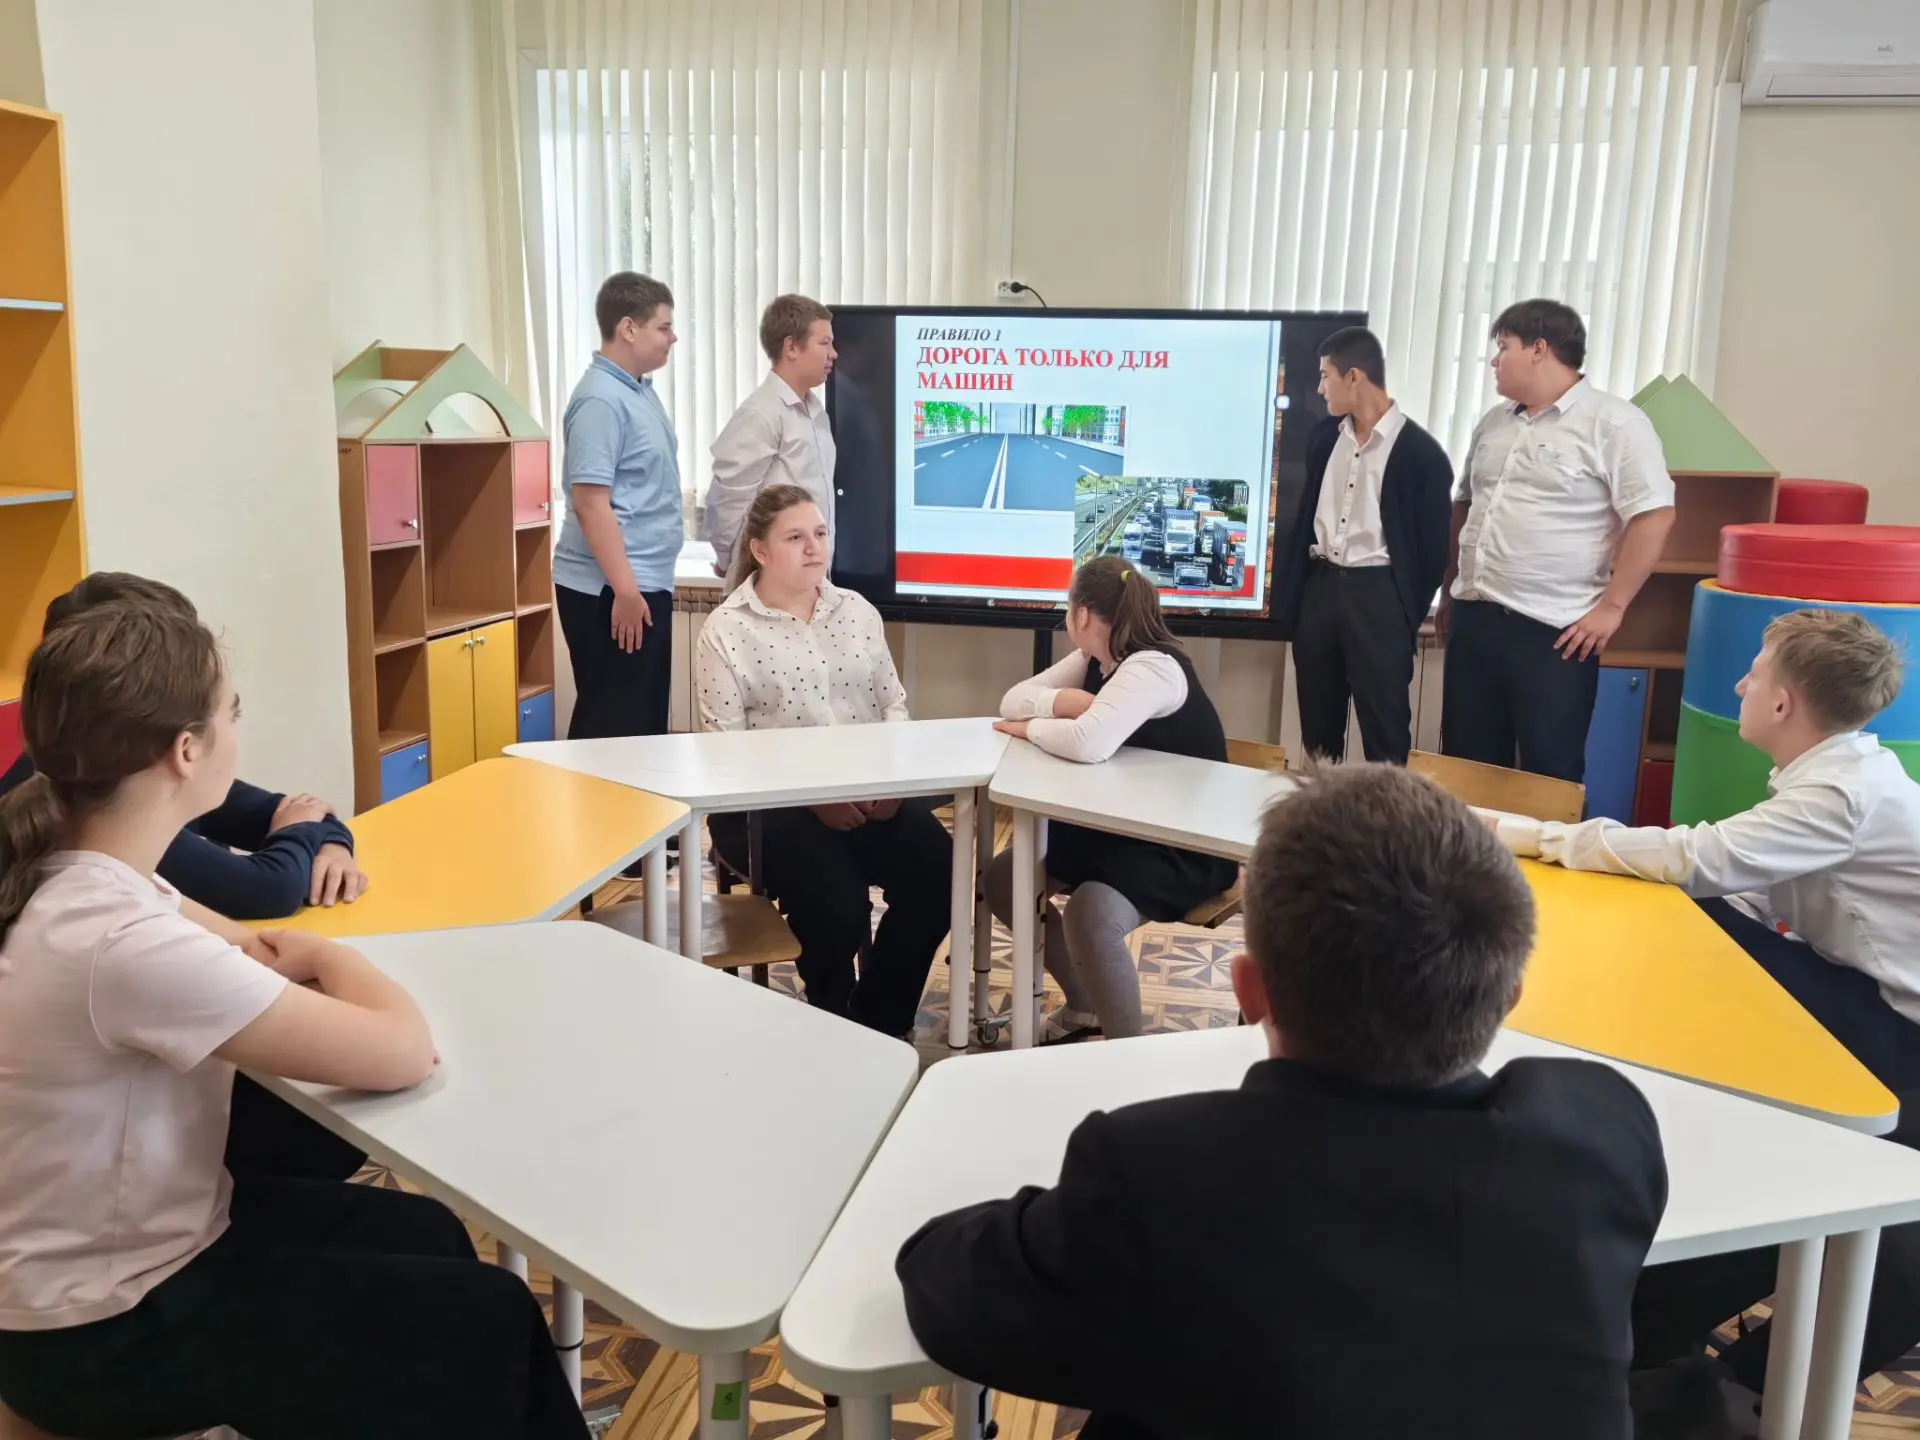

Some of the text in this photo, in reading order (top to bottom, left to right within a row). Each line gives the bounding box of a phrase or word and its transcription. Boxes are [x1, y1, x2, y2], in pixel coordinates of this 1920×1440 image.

[916, 328, 1002, 341] ПРАВИЛО 1
[916, 346, 1169, 371] ДОРОГА ТОЛЬКО ДЛЯ
[917, 371, 1015, 391] МАШИН
